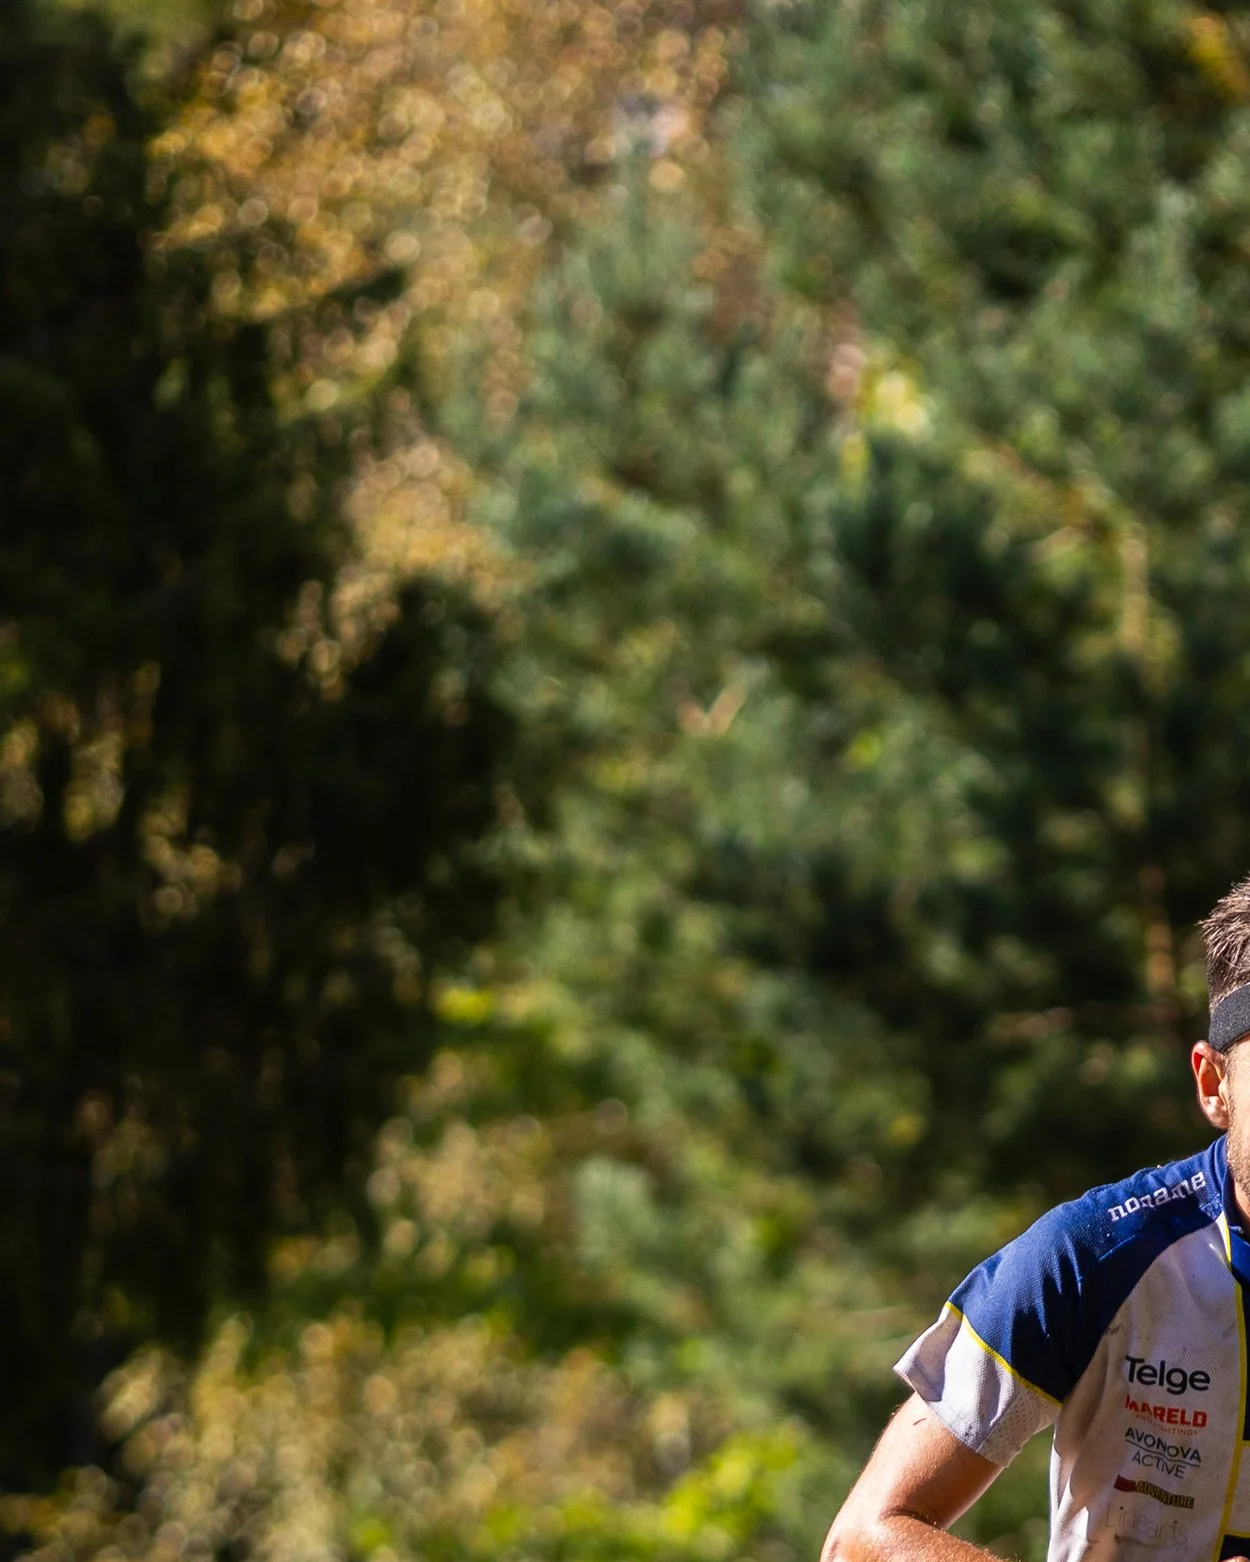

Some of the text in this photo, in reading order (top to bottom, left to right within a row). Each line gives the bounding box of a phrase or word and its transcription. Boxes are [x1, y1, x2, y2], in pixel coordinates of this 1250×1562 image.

[1108, 1171, 1207, 1222] noname
[1125, 1354, 1211, 1395] Telge
[1125, 1427, 1201, 1463] AVONOVA
[1132, 1451, 1186, 1479] ACTIVE
